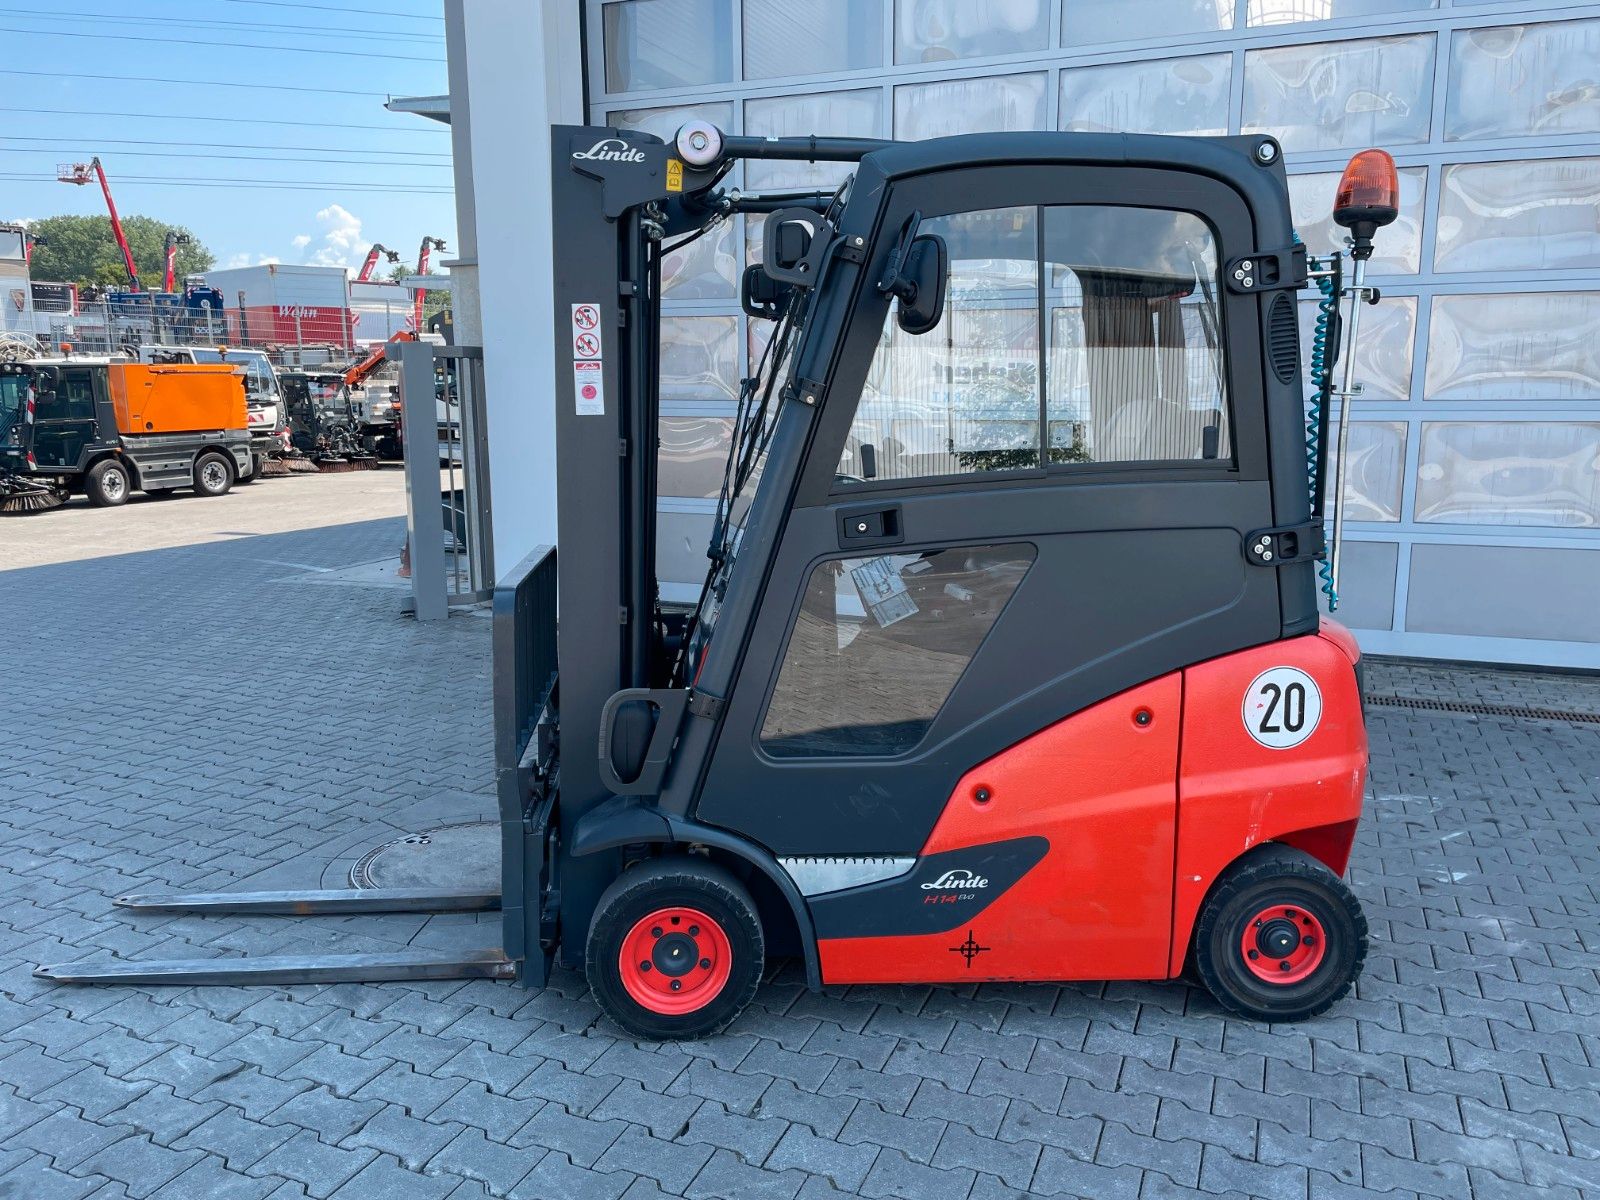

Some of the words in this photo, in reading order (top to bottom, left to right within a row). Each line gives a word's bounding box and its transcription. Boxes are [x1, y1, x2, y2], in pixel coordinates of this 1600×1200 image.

[572, 139, 646, 163] Linde
[1259, 682, 1306, 733] 20
[920, 869, 989, 890] Linde
